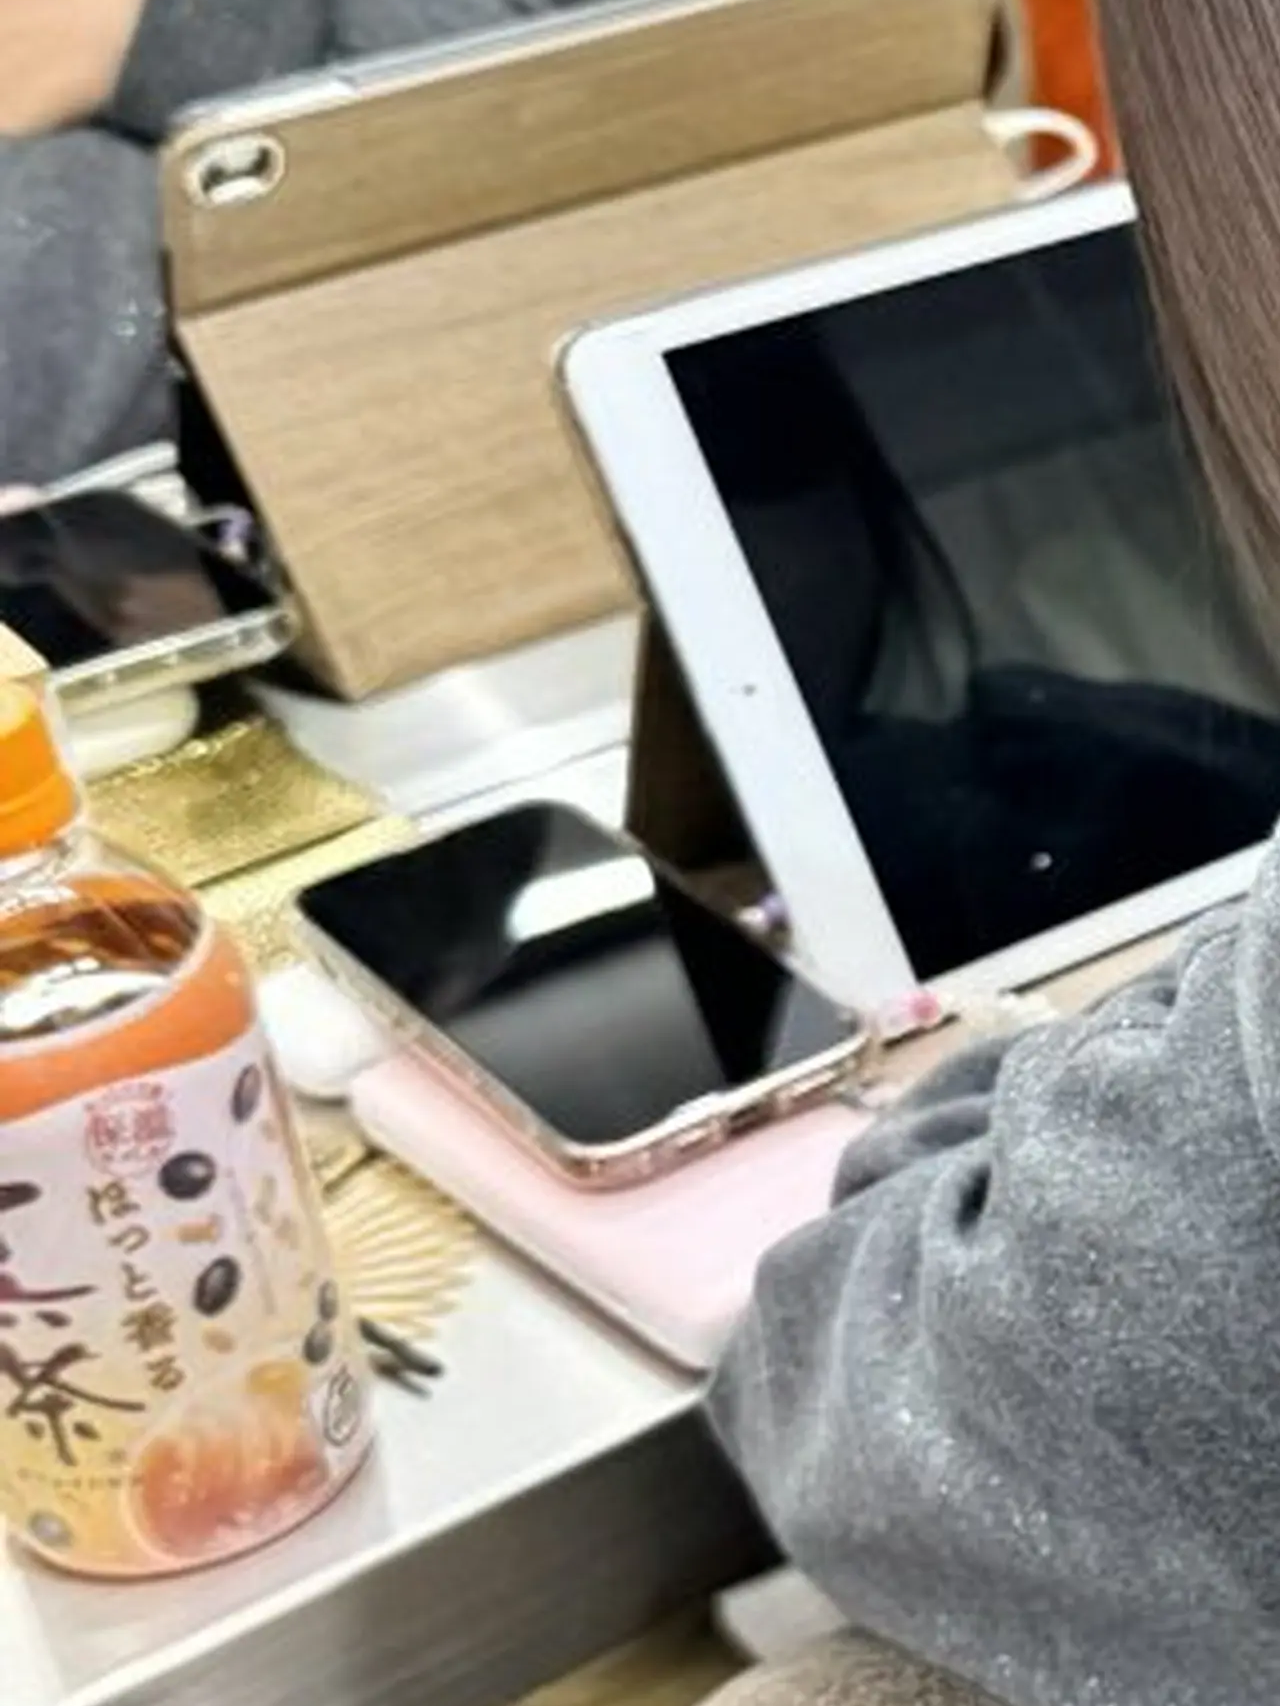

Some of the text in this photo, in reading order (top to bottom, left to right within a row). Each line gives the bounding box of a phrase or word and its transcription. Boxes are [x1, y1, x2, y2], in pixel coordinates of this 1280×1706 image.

[86, 1179, 186, 1391] ほっと香る
